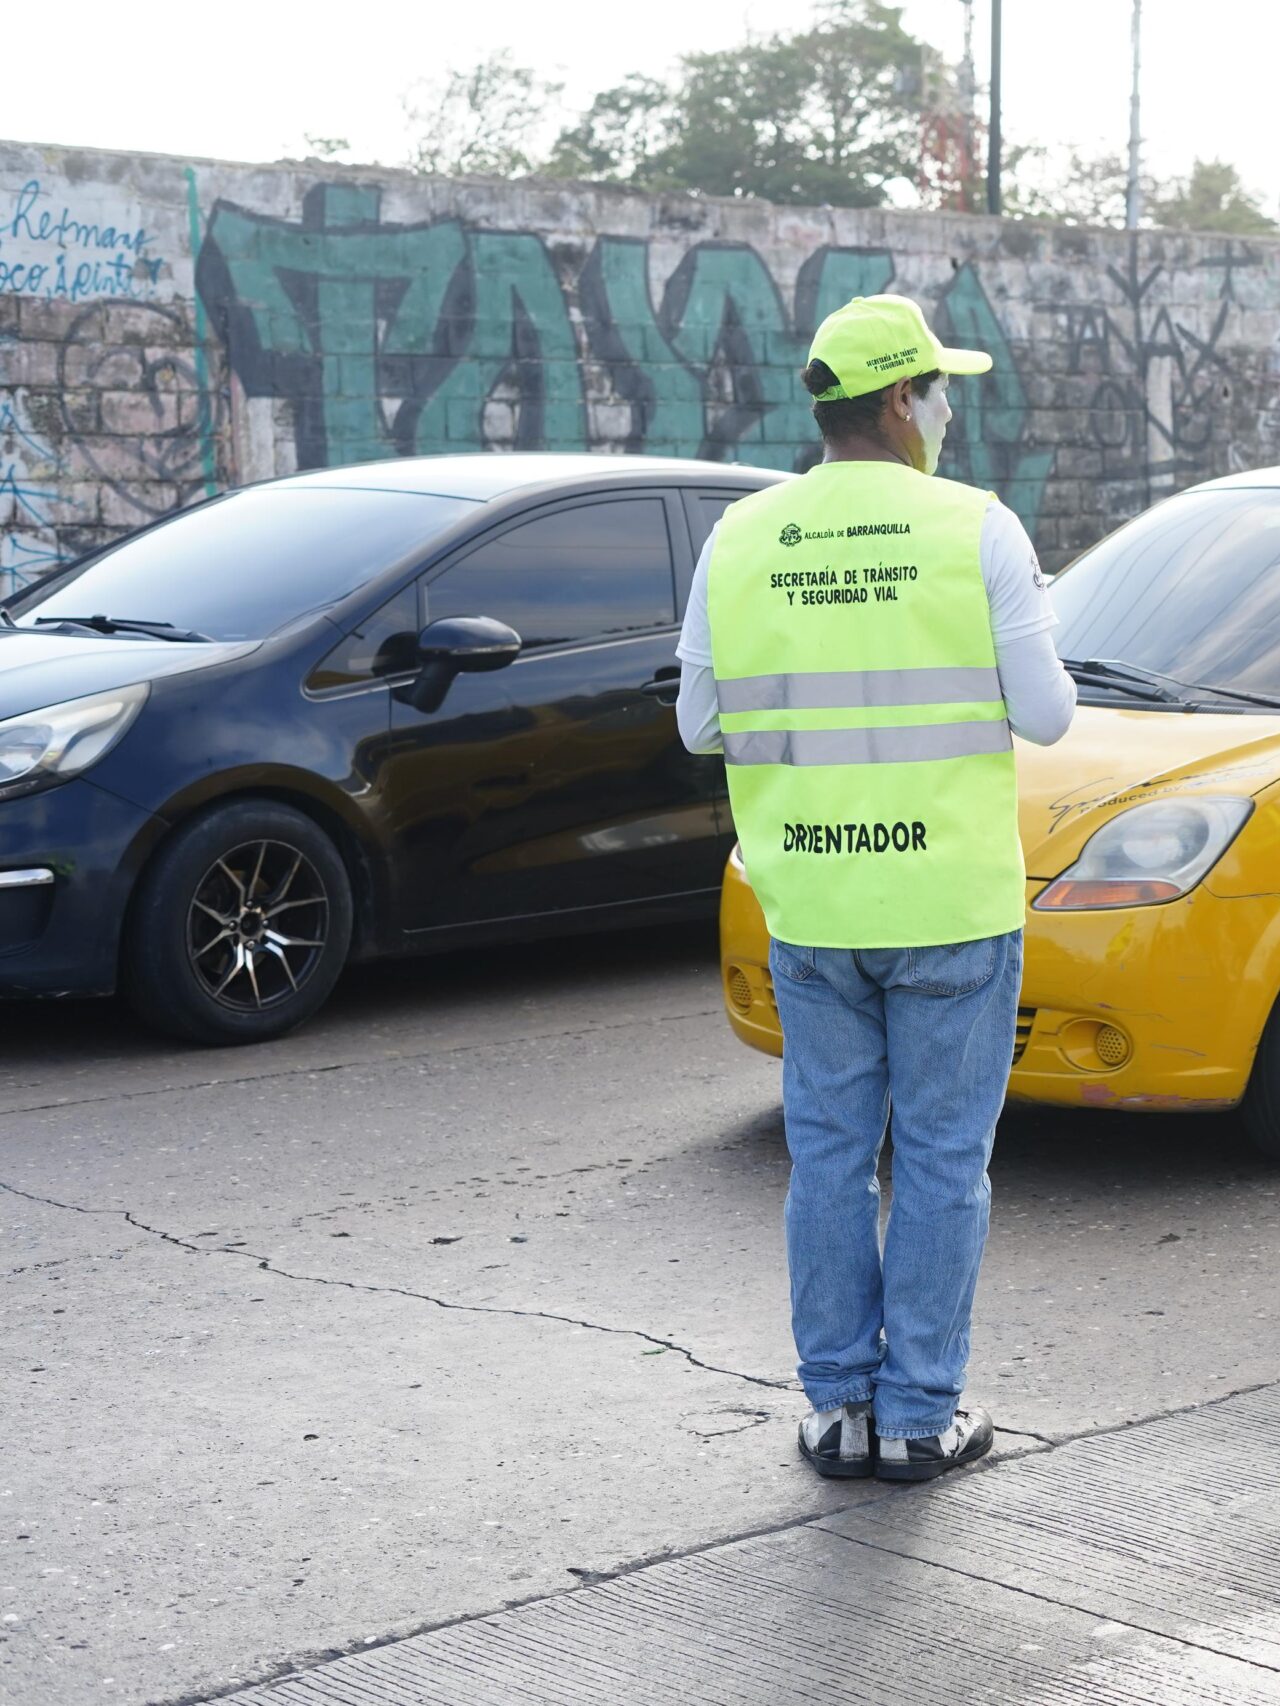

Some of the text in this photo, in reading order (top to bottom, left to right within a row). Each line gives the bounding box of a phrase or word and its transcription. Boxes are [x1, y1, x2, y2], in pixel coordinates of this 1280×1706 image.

[866, 353, 892, 367] SECRETARÍA
[899, 347, 918, 358] TRÁNSITO
[874, 356, 916, 373] Y SEGURIDAD VIAL
[837, 530, 845, 538] DE
[847, 523, 911, 538] BARRANQUILLA
[770, 561, 918, 588] SECRETARÍA DE TRÁNSITO
[787, 586, 898, 606] Y SEGURIDAD VIAL
